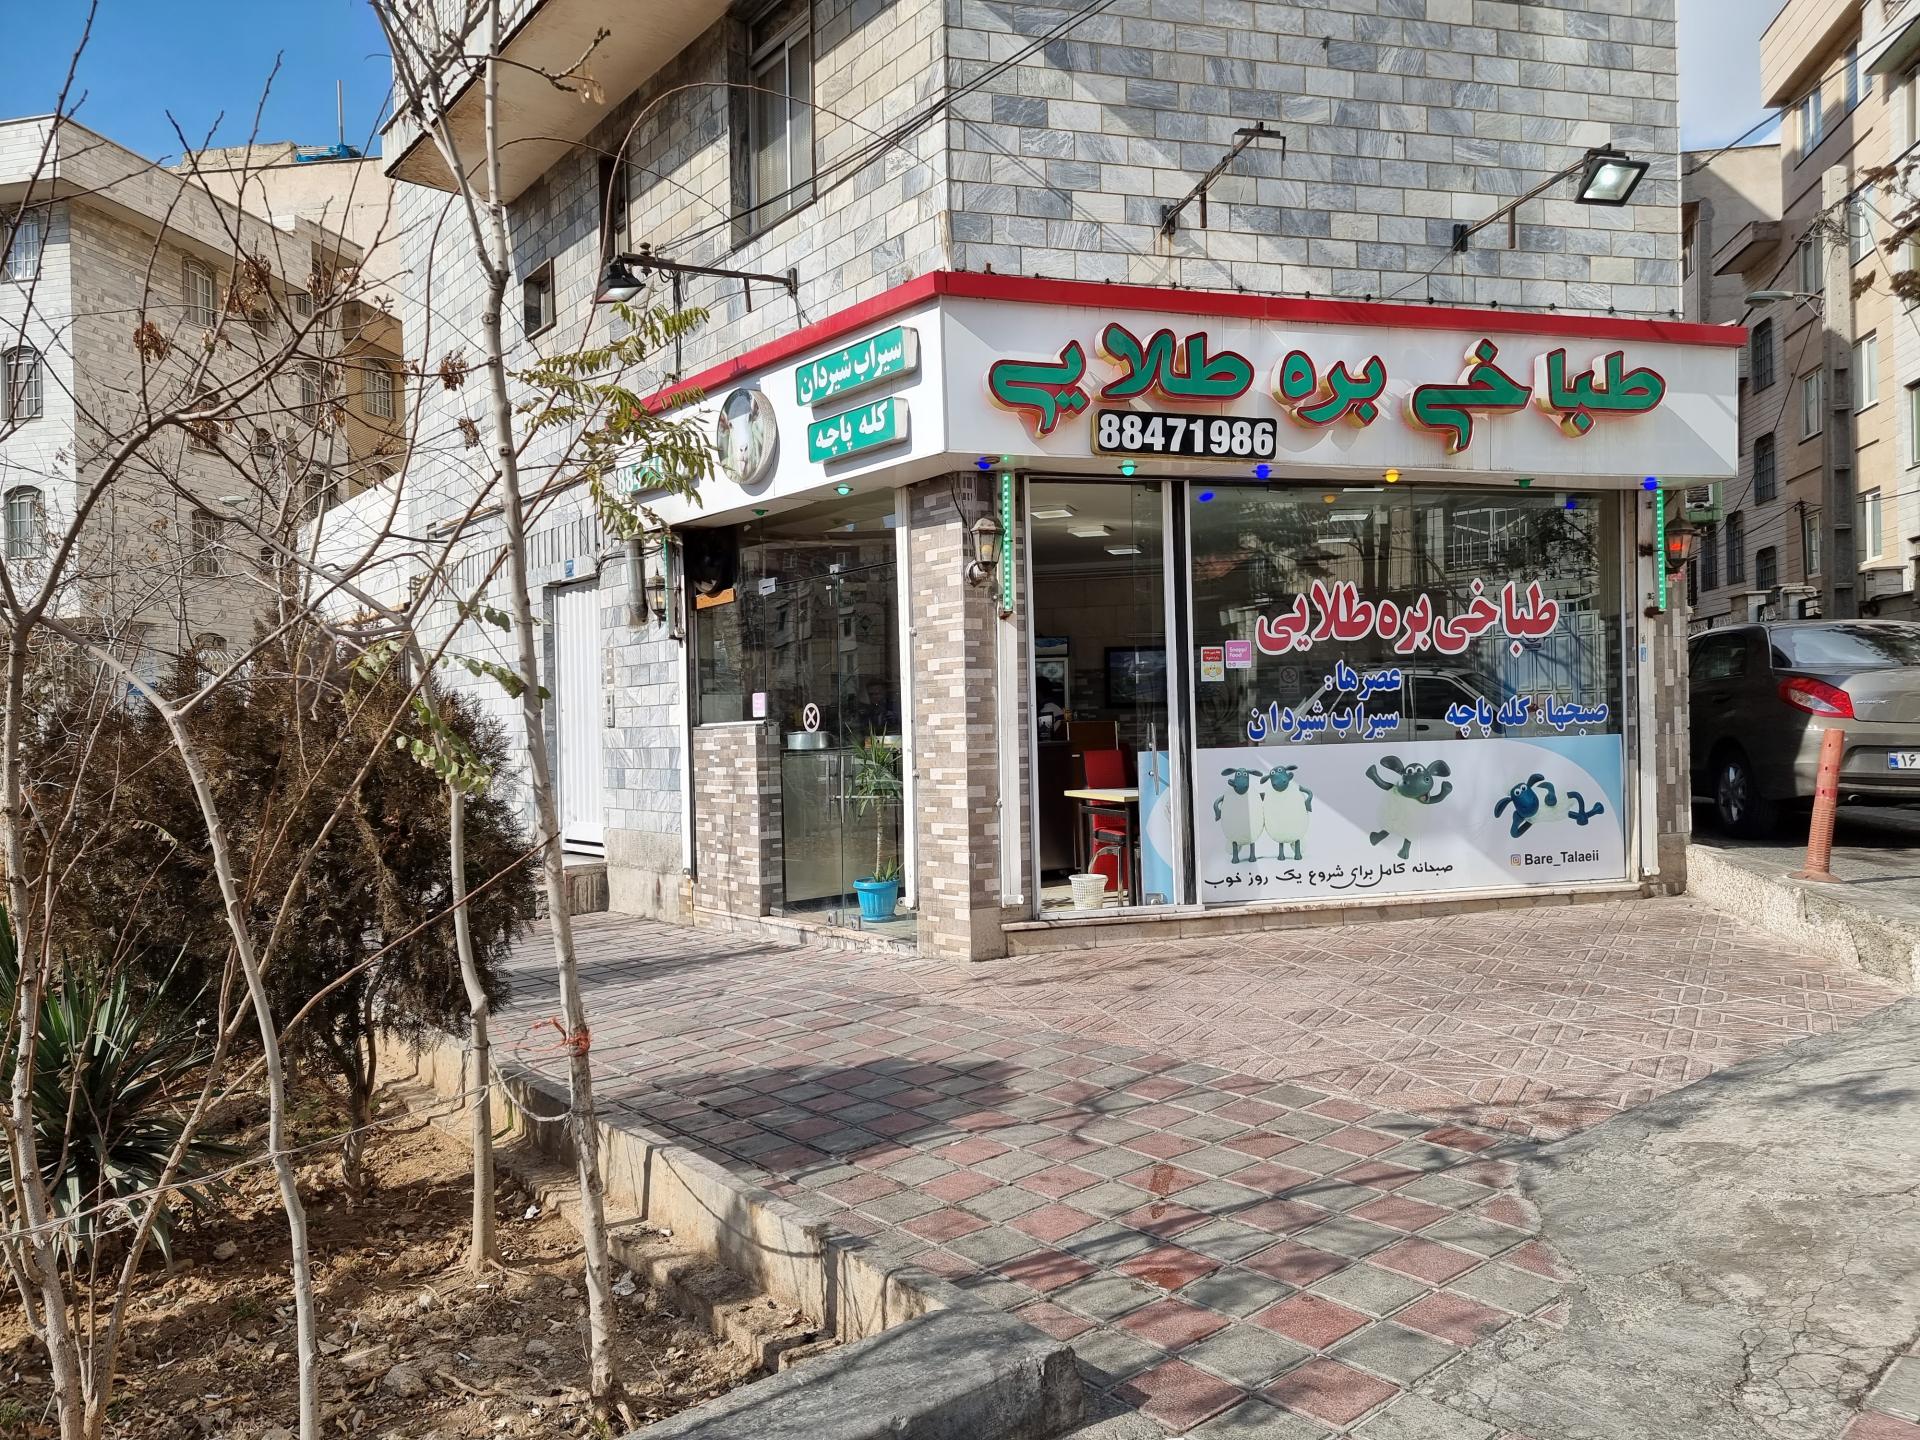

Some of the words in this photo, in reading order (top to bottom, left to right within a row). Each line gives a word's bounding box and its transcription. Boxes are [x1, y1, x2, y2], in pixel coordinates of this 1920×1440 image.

[800, 351, 852, 403] شیردان
[853, 339, 902, 380] سیراب
[988, 322, 1256, 435] طلایی
[1276, 349, 1388, 428] بره
[1406, 338, 1667, 453] طباخی
[815, 415, 853, 455] پاچه
[858, 400, 889, 435] کله
[1099, 413, 1275, 456] 88471986
[1255, 579, 1376, 656] طلایی
[1376, 592, 1432, 654] بره
[1433, 577, 1560, 658] طباخی
[1248, 700, 1328, 741] شیردان
[1331, 702, 1400, 741] سیراب
[1445, 696, 1494, 738] پاچه
[1497, 695, 1532, 727] کله
[1275, 868, 1302, 884] یک
[1308, 864, 1344, 886] شروع
[1329, 864, 1374, 889] برای
[1355, 863, 1406, 888] کامل
[1411, 862, 1454, 877] صبحانه
[1524, 849, 1599, 867] Bare_Talaeii
[1204, 872, 1242, 888] خوب
[1248, 874, 1268, 887] روز
